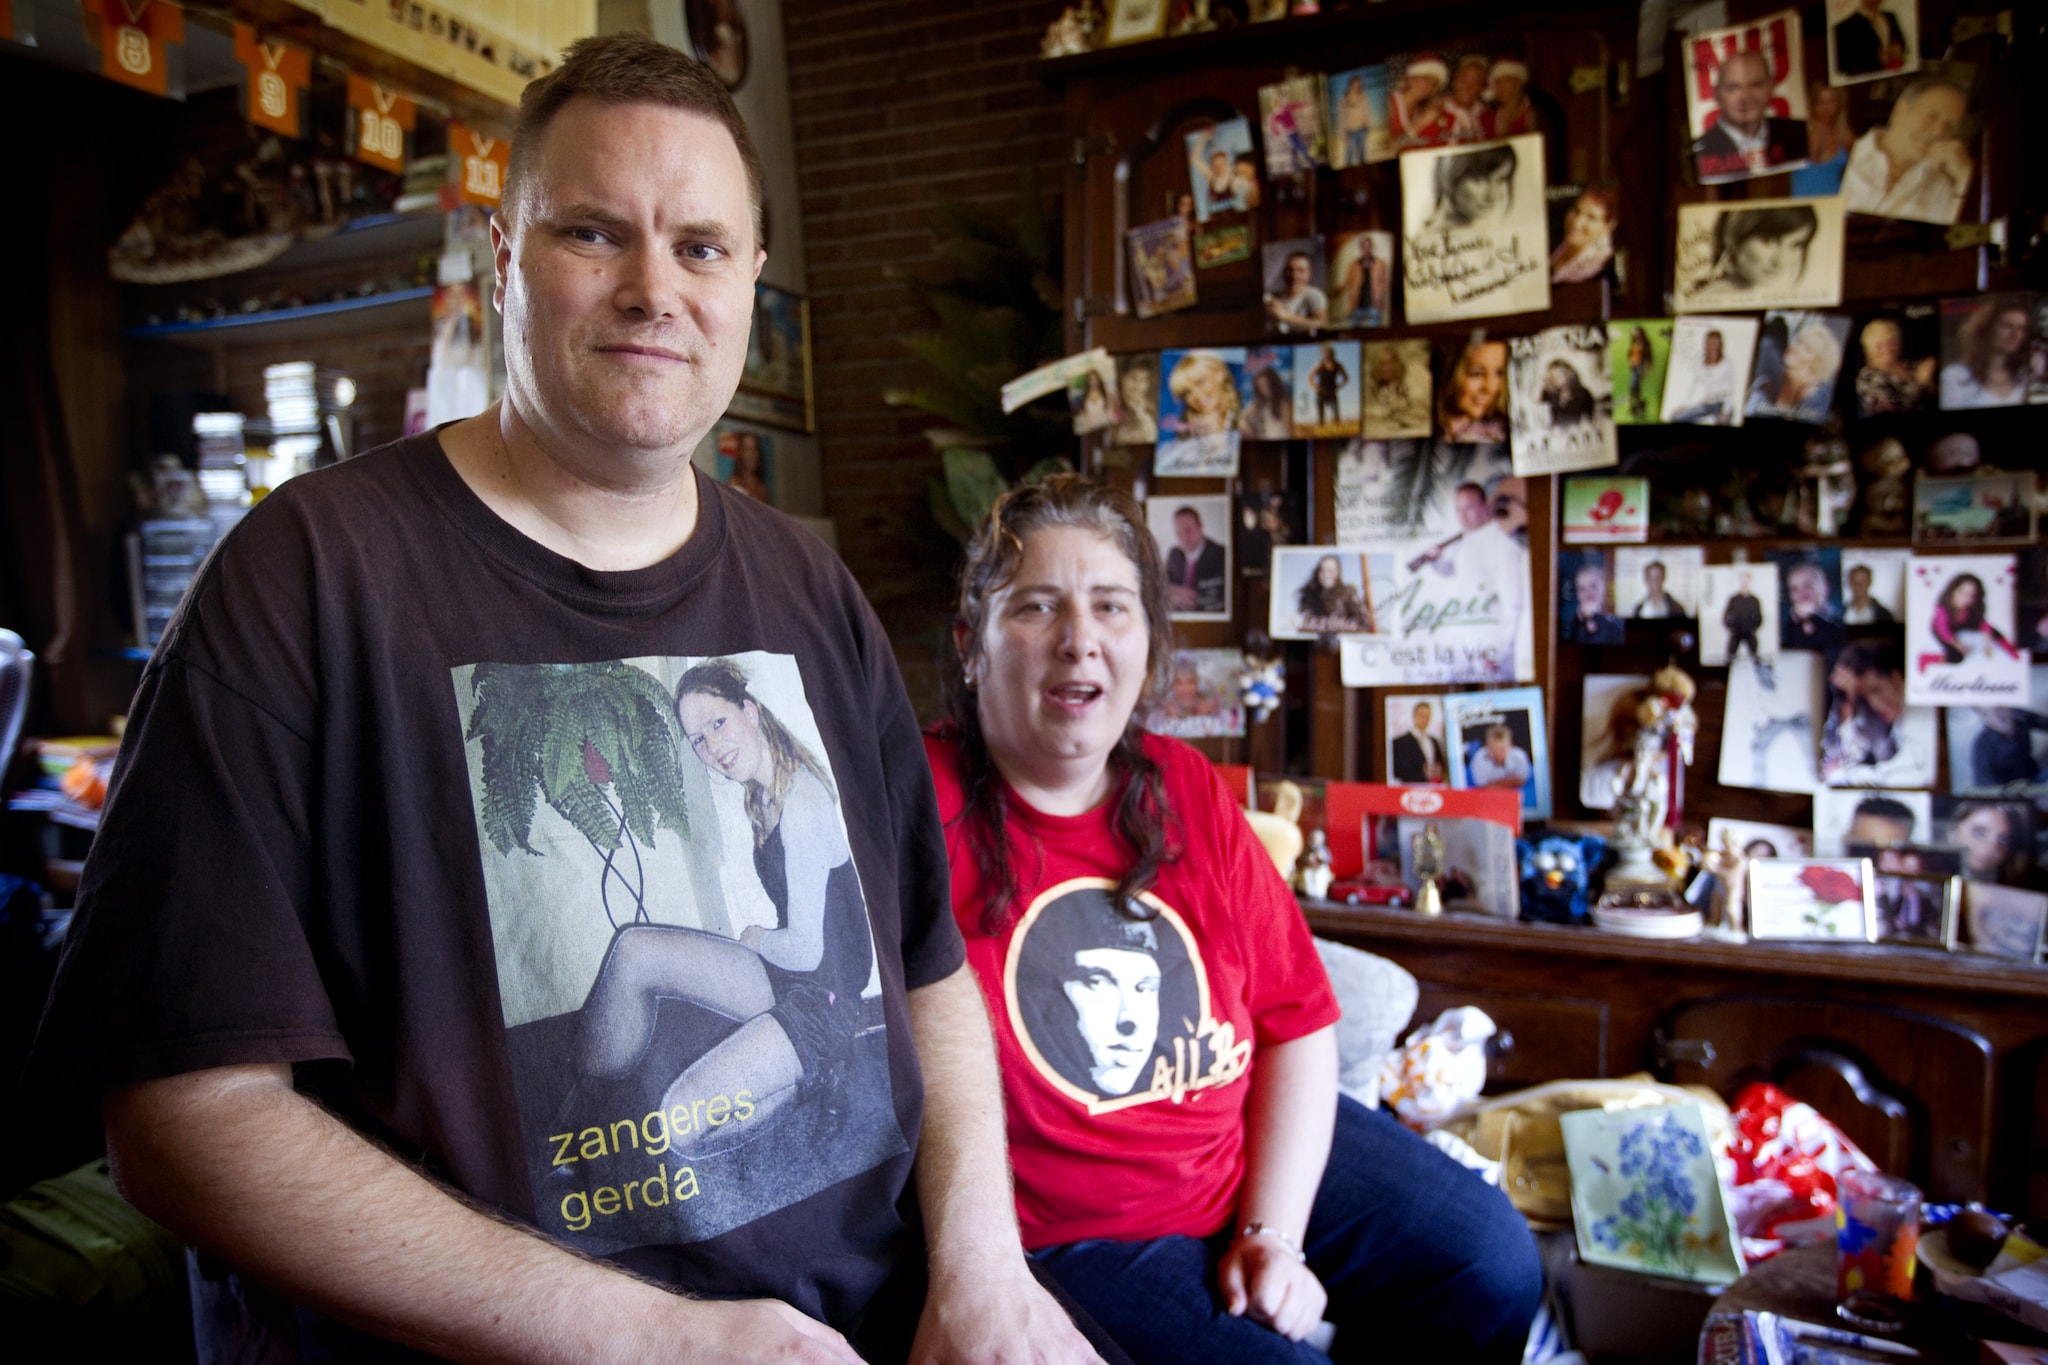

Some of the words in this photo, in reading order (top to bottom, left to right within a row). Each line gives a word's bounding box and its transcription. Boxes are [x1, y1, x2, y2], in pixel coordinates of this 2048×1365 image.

[258, 71, 288, 118] 9
[360, 107, 403, 160] 10
[465, 153, 501, 199] 11
[1434, 641, 1455, 663] la
[548, 1088, 756, 1167] zangeres
[560, 1163, 701, 1232] gerda
